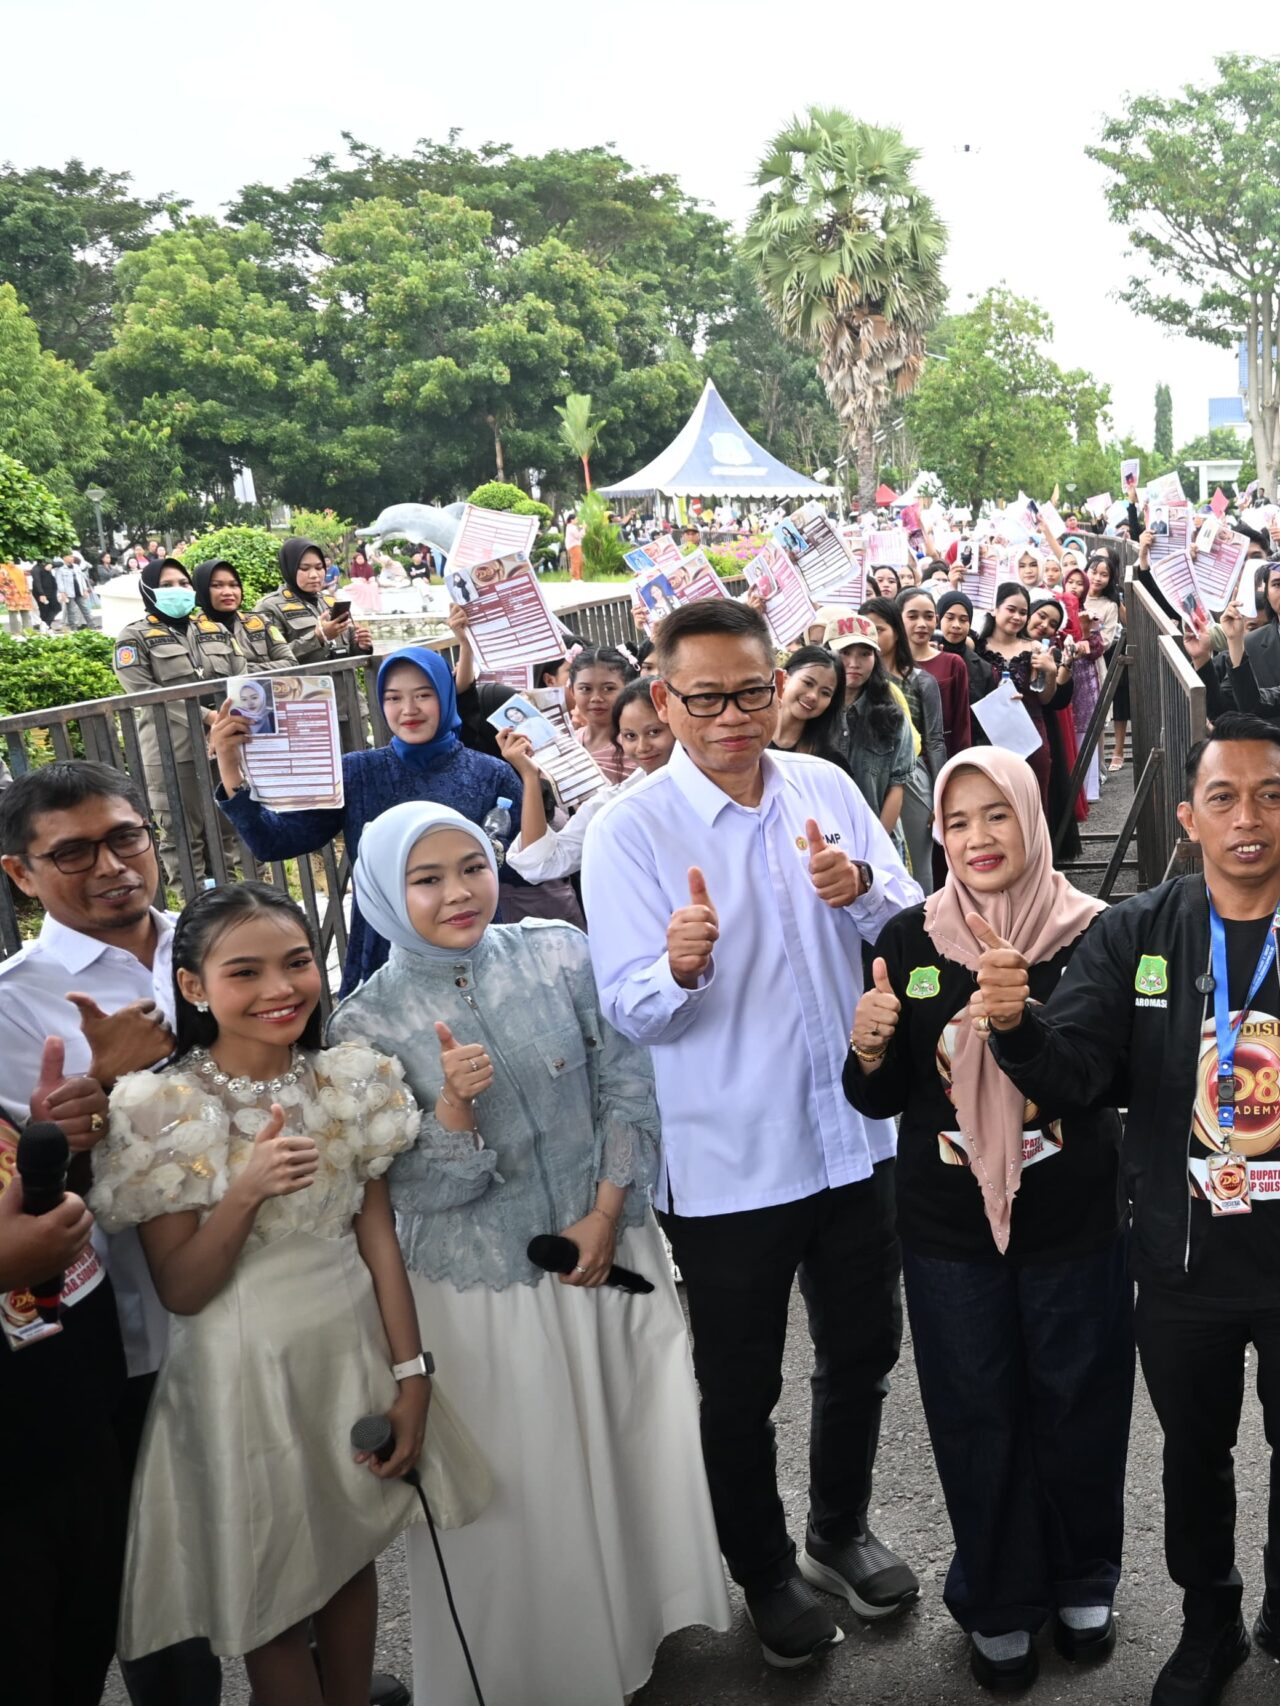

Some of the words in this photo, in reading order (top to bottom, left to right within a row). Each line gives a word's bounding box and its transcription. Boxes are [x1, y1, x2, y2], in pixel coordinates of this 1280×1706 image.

[837, 617, 870, 636] NY
[822, 833, 841, 844] MP
[1242, 1022, 1280, 1037] DISI
[1230, 1105, 1280, 1116] ADEMY
[1250, 1169, 1280, 1181] BUPATI
